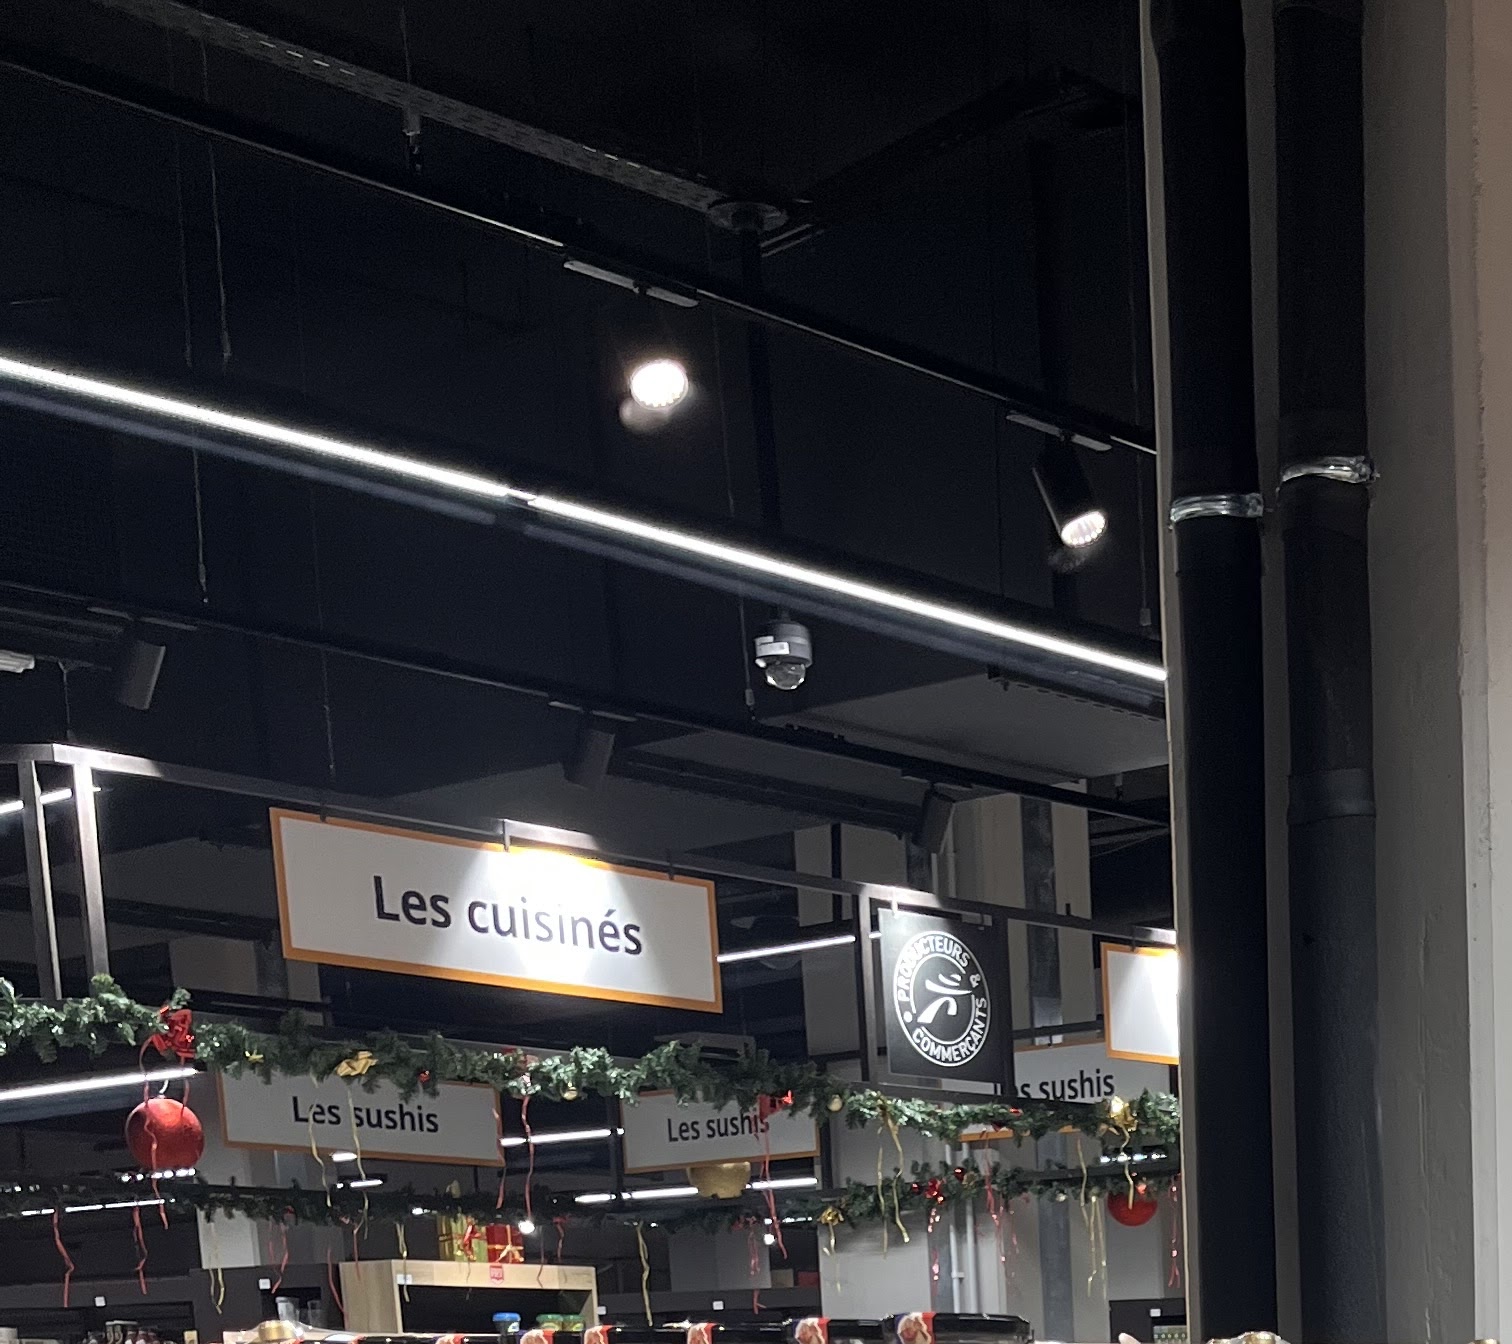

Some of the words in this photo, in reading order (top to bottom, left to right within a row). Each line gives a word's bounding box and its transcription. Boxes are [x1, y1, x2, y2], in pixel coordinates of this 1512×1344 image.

[373, 875, 452, 928] Les
[468, 896, 643, 956] cuisinés
[1039, 1068, 1115, 1100] sushis
[291, 1096, 341, 1125] Les
[353, 1103, 439, 1133] sushis
[667, 1118, 700, 1142] Les
[706, 1112, 769, 1138] sushis
